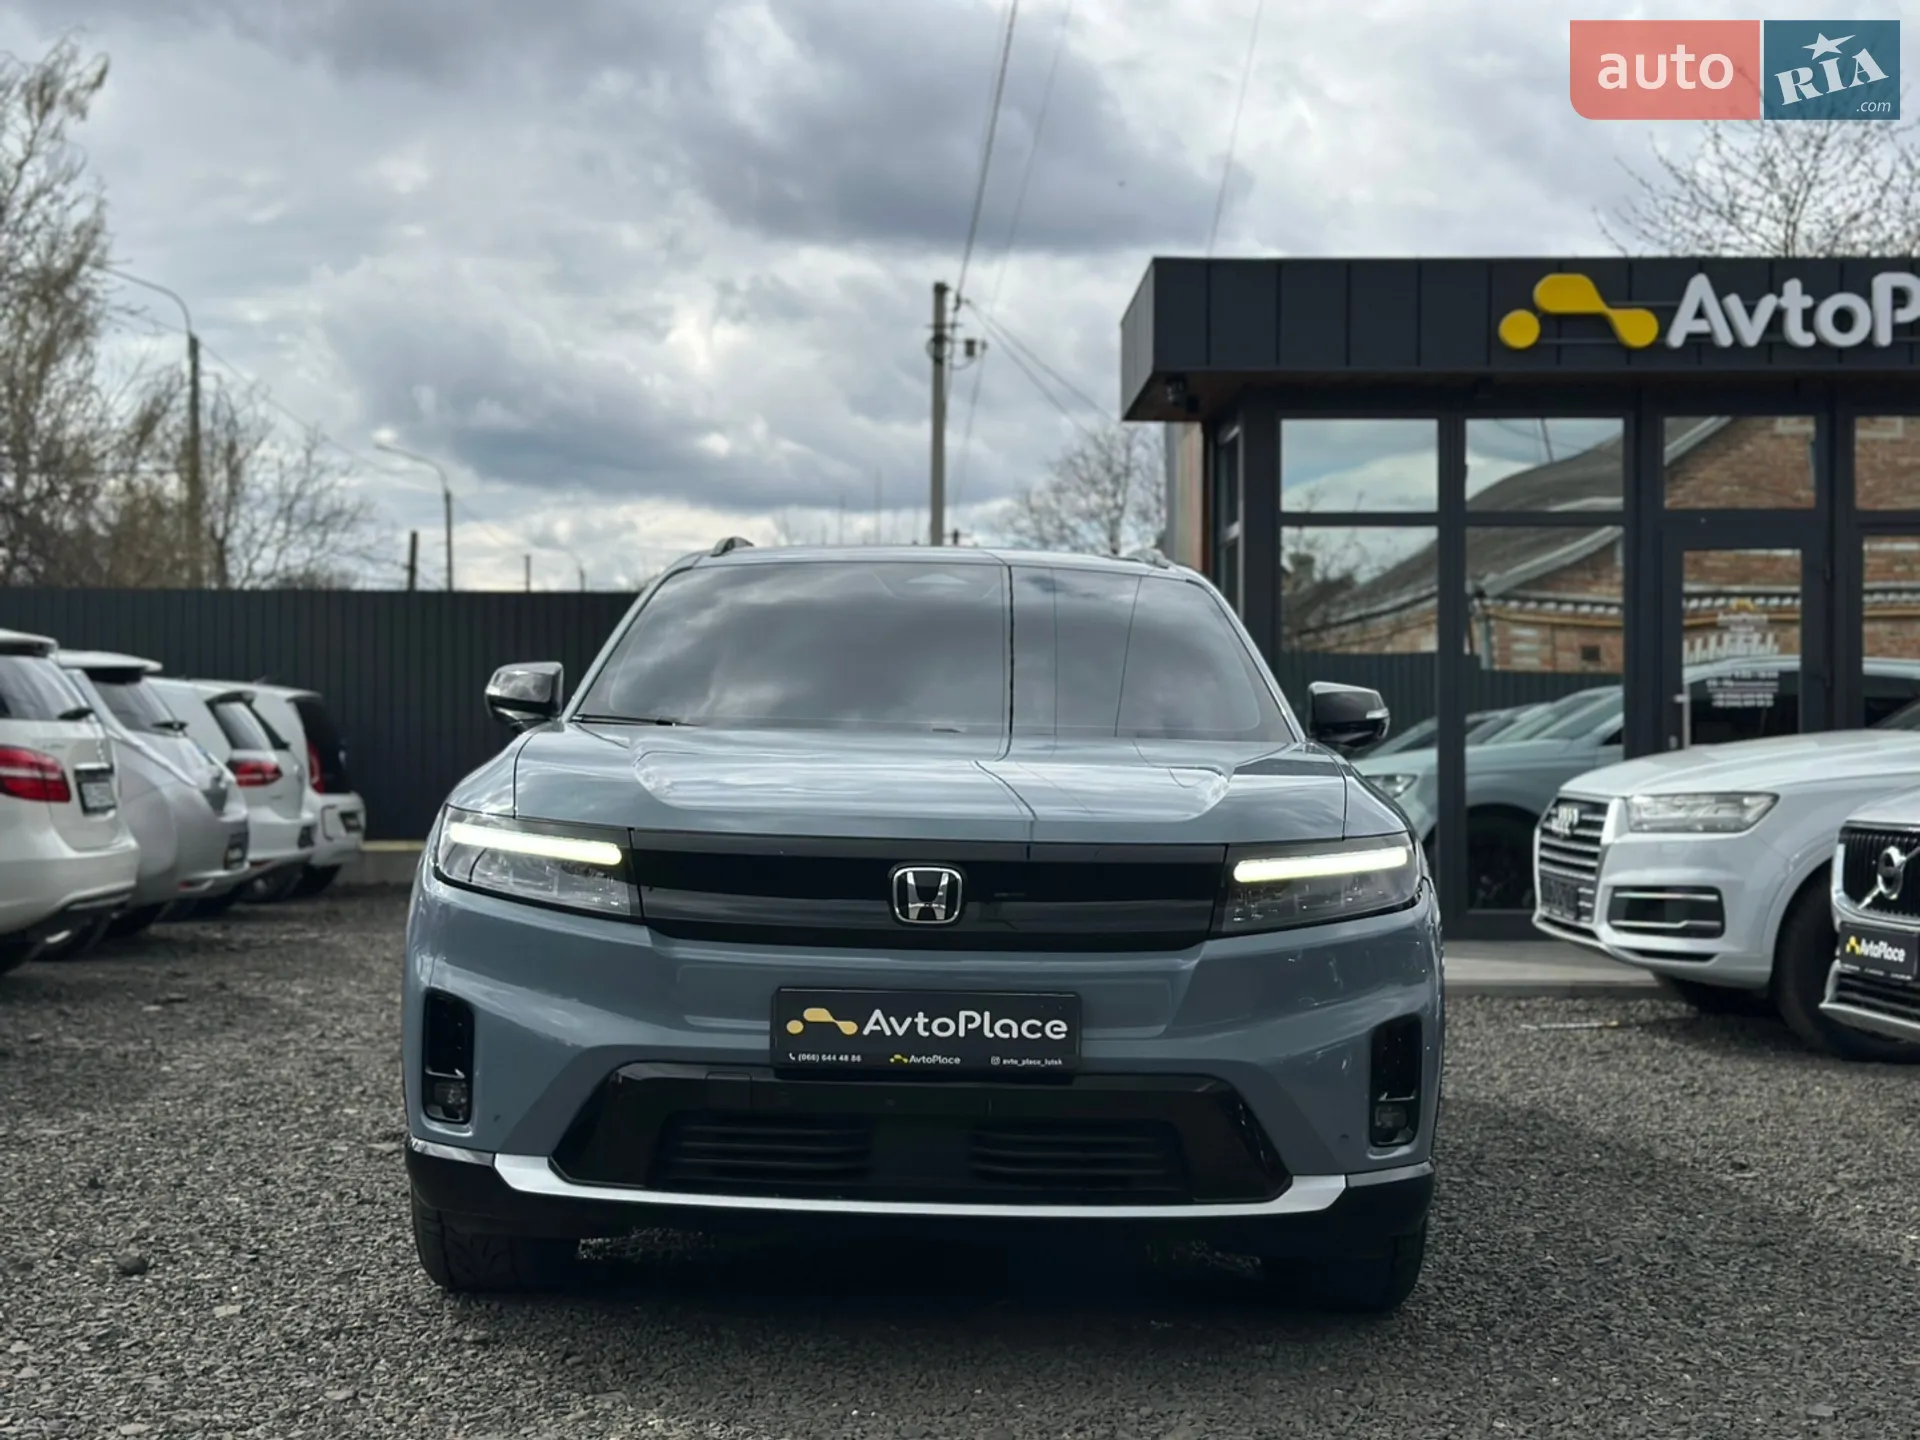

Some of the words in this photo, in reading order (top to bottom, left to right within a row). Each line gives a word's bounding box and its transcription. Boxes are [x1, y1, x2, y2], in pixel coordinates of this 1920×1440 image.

[1861, 938, 1905, 963] AvtoPlace
[863, 1009, 1068, 1040] AvtoPlace
[909, 1054, 961, 1065] AvtoPlace
